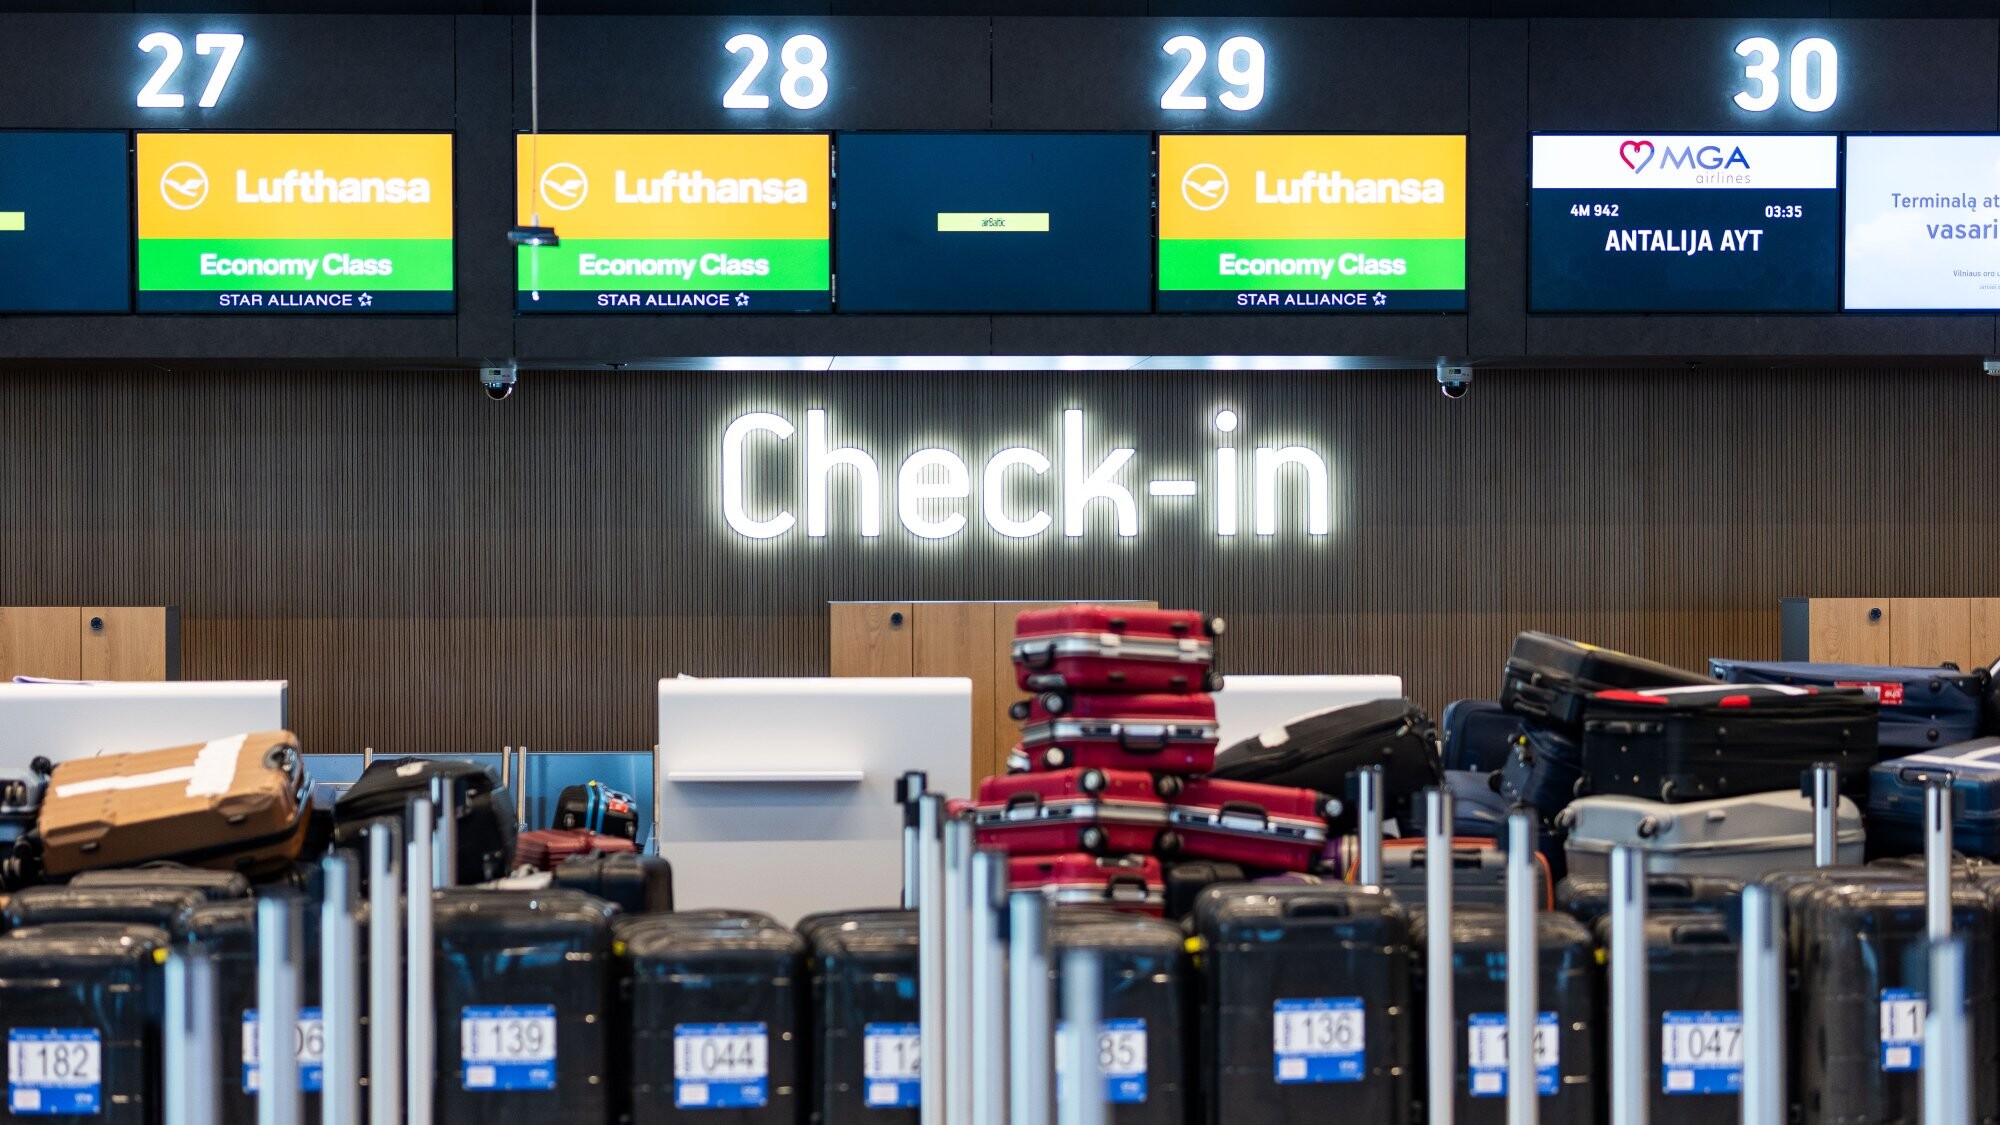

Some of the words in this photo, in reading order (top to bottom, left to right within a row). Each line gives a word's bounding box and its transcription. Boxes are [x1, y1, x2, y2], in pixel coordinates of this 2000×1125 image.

[137, 32, 244, 108] 27
[723, 34, 828, 109] 28
[1161, 36, 1265, 110] 29
[1733, 37, 1838, 112] 30
[1660, 146, 1750, 169] MGA
[236, 168, 431, 204] Lufthansa
[615, 168, 808, 204] Lufthansa
[1255, 169, 1444, 205] Lufthansa
[1696, 172, 1751, 183] airlines
[1570, 205, 1591, 217] 4M
[1594, 205, 1619, 217] 942
[1765, 206, 1803, 218] 03:35
[1892, 193, 1977, 212] Terminalą
[1605, 229, 1714, 256] ANTALIJA
[1720, 229, 1764, 252] AYT
[1926, 218, 1998, 239] vasari
[201, 253, 319, 280] Economy
[322, 253, 392, 276] Class
[579, 253, 697, 280] Economy
[700, 253, 770, 276] Class
[1219, 253, 1336, 280] Economy
[1338, 253, 1407, 276] Class
[219, 294, 262, 306] STAR
[267, 294, 353, 306] ALLIANCE
[597, 294, 641, 306] STAR
[645, 294, 730, 306] ALLIANCE
[1237, 293, 1280, 305] STAR
[1284, 293, 1367, 305] ALLIANCE
[721, 408, 1329, 540] Check-in
[491, 1020, 543, 1055] 139
[1302, 1013, 1353, 1048] 136
[1498, 1030, 1545, 1060] 14
[1688, 1026, 1741, 1058] 047
[38, 1044, 89, 1078] 182
[701, 1038, 754, 1073] 044
